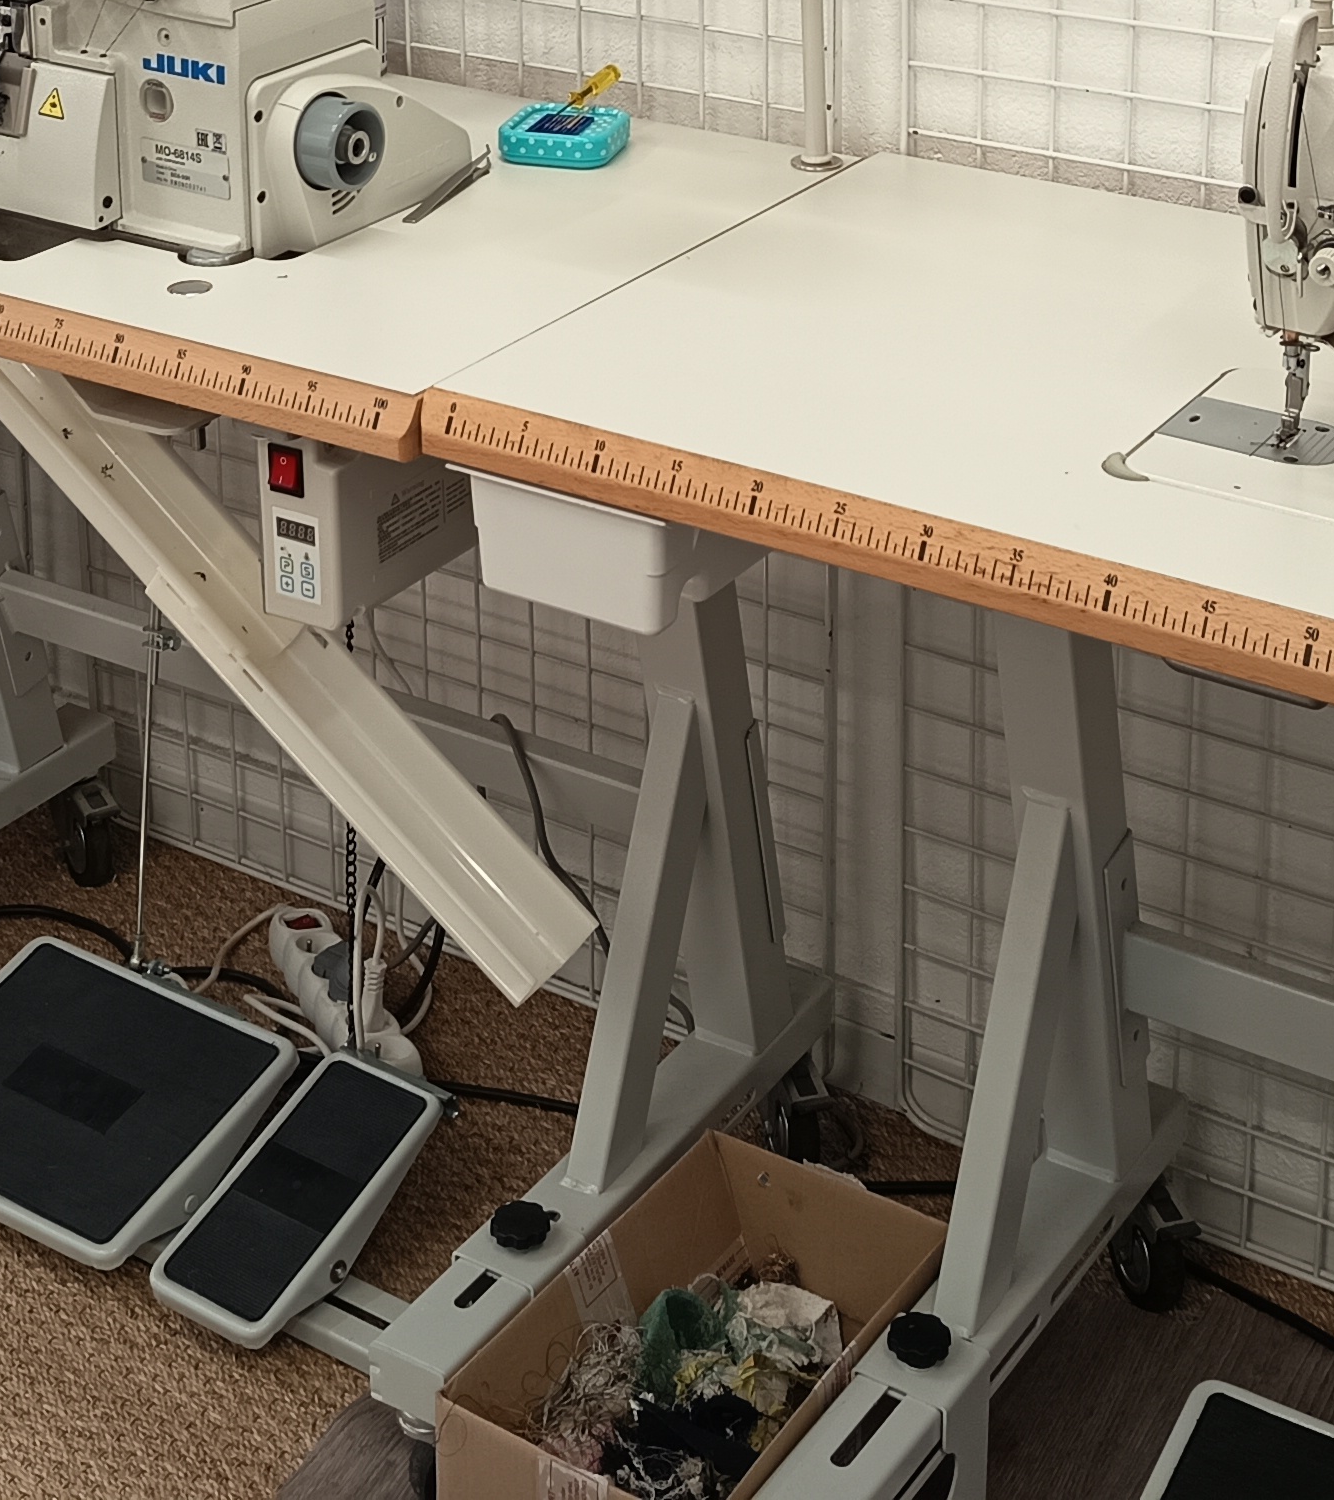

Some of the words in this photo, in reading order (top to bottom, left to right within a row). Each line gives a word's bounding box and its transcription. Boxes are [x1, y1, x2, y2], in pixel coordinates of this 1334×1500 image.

[142, 53, 226, 85] JUKI
[155, 144, 201, 163] MO-6814S
[373, 397, 388, 410] 100
[671, 460, 683, 473] 15
[751, 480, 763, 493] 20
[833, 502, 847, 515] 25
[920, 524, 933, 538] 30
[1009, 548, 1024, 562] 35
[1102, 573, 1118, 588] 40
[1201, 599, 1218, 614] 45
[1303, 626, 1319, 642] 50
